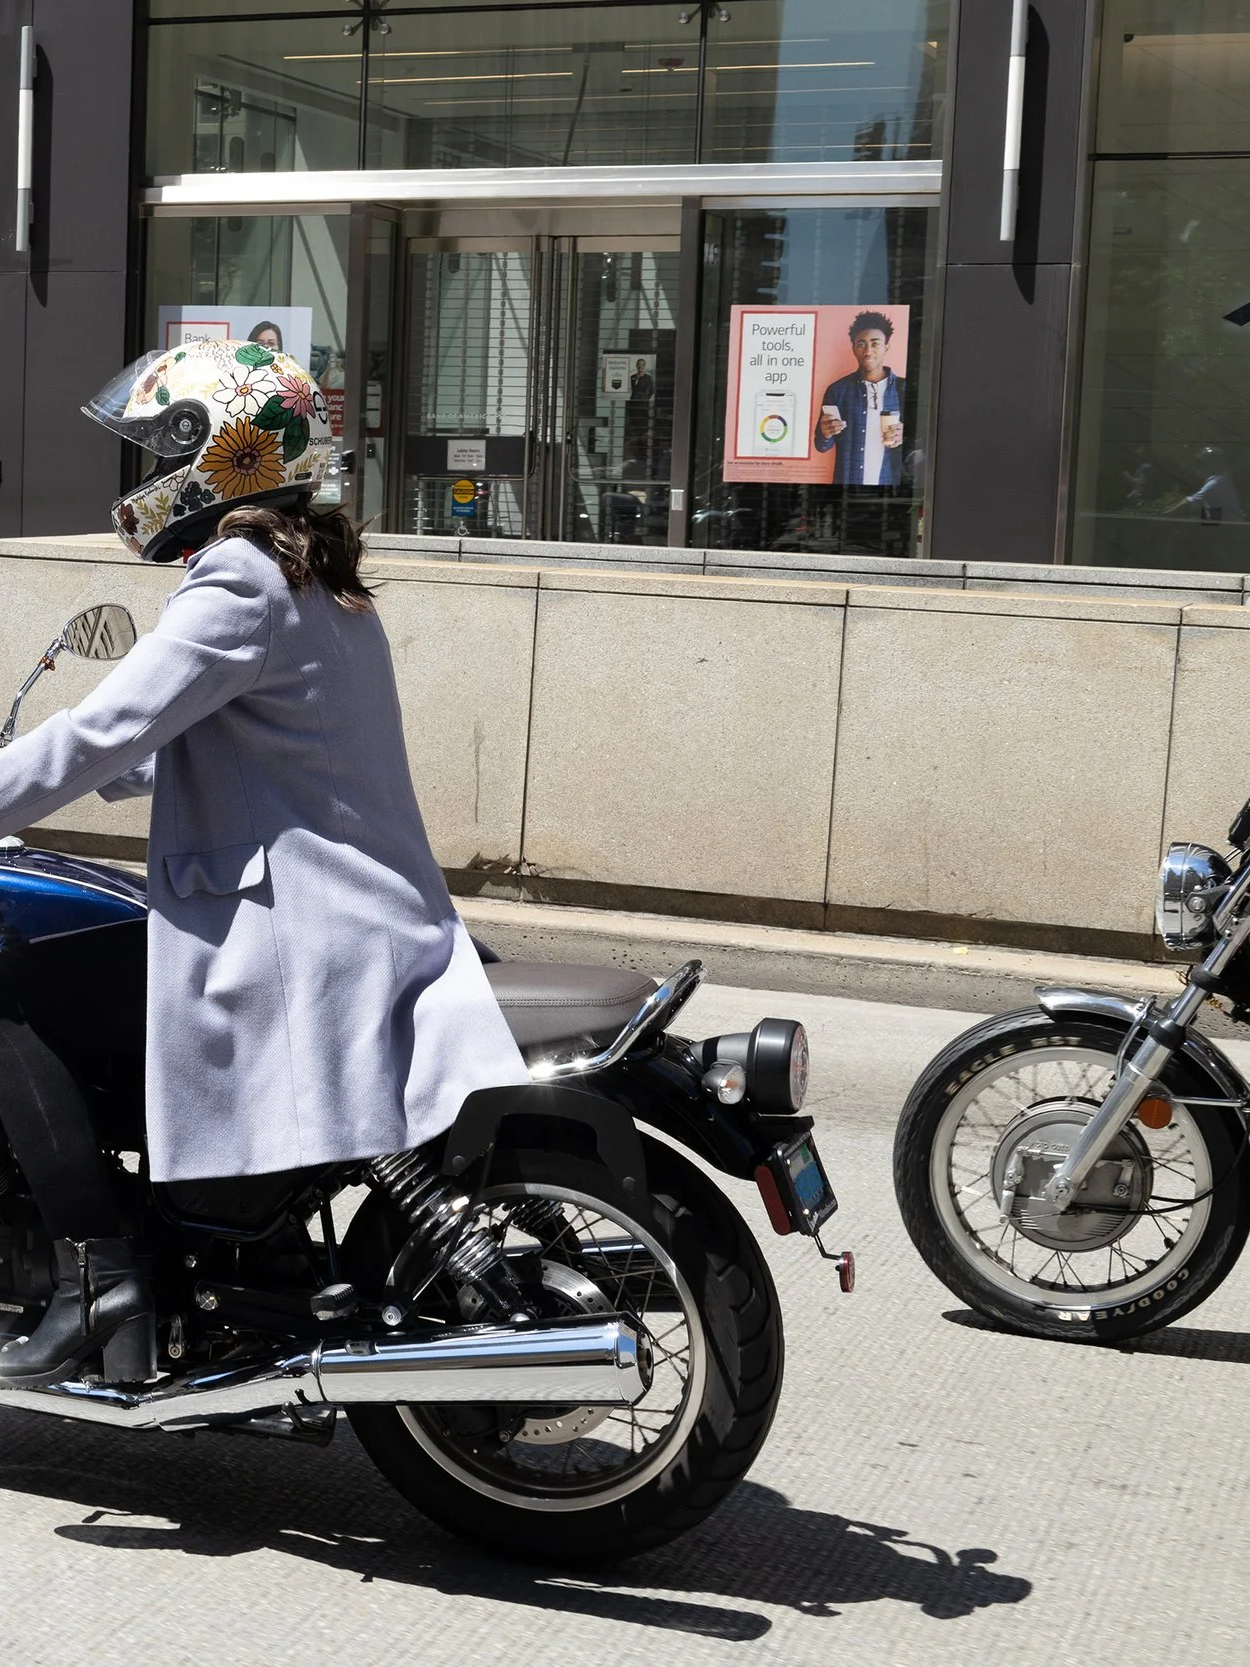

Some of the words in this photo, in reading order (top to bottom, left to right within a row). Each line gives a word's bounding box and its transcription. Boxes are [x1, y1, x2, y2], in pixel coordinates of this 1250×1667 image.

[752, 323, 806, 336] Powerful
[762, 339, 794, 352] tools,
[749, 354, 763, 366] all
[767, 355, 778, 366] in
[781, 356, 805, 367] one
[765, 372, 788, 384] app
[945, 1044, 1017, 1096] EAGLE
